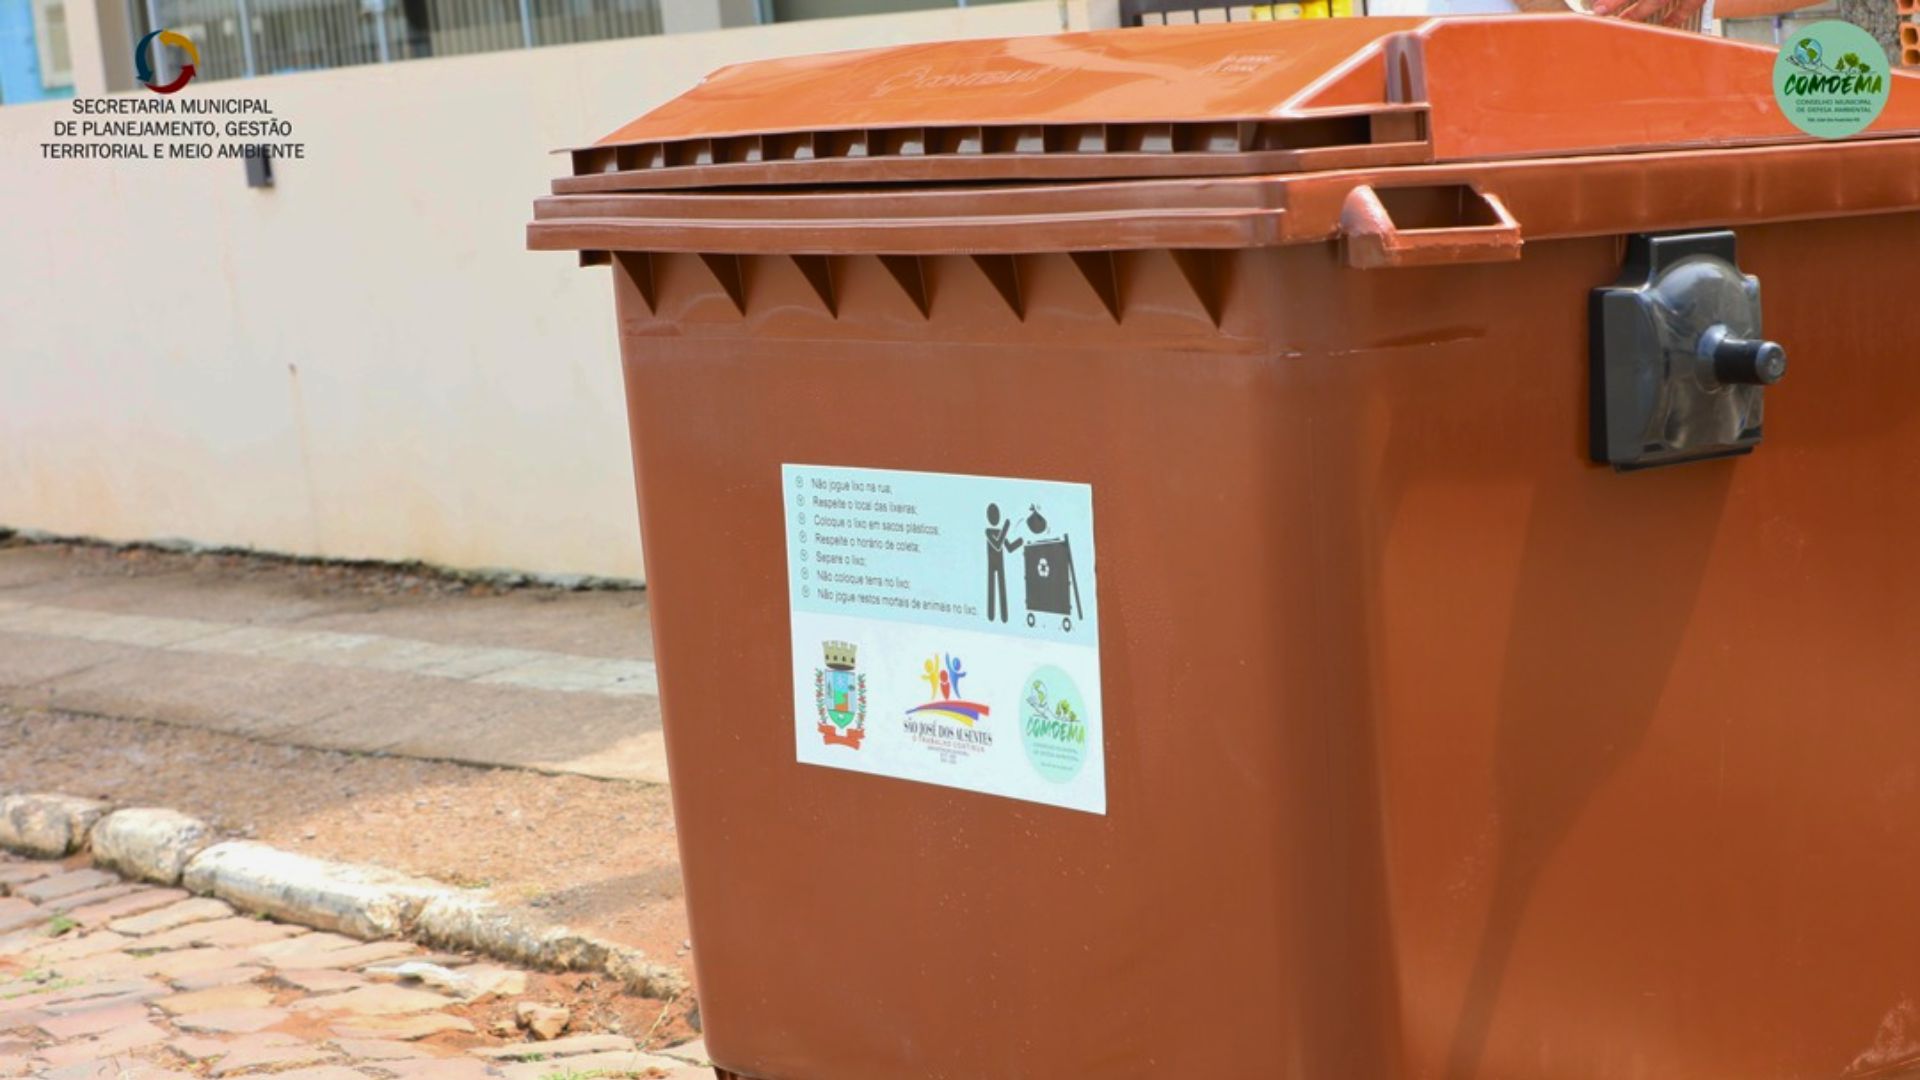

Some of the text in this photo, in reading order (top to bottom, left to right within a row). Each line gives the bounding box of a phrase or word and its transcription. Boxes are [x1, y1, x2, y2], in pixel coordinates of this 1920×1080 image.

[811, 478, 827, 489] Não
[829, 480, 850, 493] jogue
[851, 480, 864, 492] lixo
[866, 483, 876, 493] na
[812, 495, 846, 509] Respeite
[848, 501, 853, 510] o
[855, 499, 871, 511] local
[874, 499, 888, 512] das
[814, 514, 845, 528] Coloque
[847, 519, 852, 528] o
[853, 517, 867, 529] lixo
[868, 520, 880, 530] em
[882, 521, 904, 532] sacos
[815, 533, 848, 547] Respeite
[849, 538, 855, 547] o
[856, 536, 883, 549] horário
[885, 539, 895, 550] de
[844, 555, 850, 564] o
[817, 570, 832, 582] Não
[833, 572, 864, 585] coloque
[865, 575, 882, 587] terra
[884, 578, 895, 588] no
[817, 588, 833, 600] Não
[835, 591, 855, 604] jogue
[857, 594, 880, 605] restos
[881, 596, 909, 608] mortais
[911, 597, 921, 610] de
[922, 600, 951, 612] animais
[952, 604, 962, 614] no
[903, 717, 918, 733] SÃO
[919, 720, 936, 737] JOSÉ
[938, 725, 954, 738] DOS
[1025, 716, 1085, 744] COMDEMA
